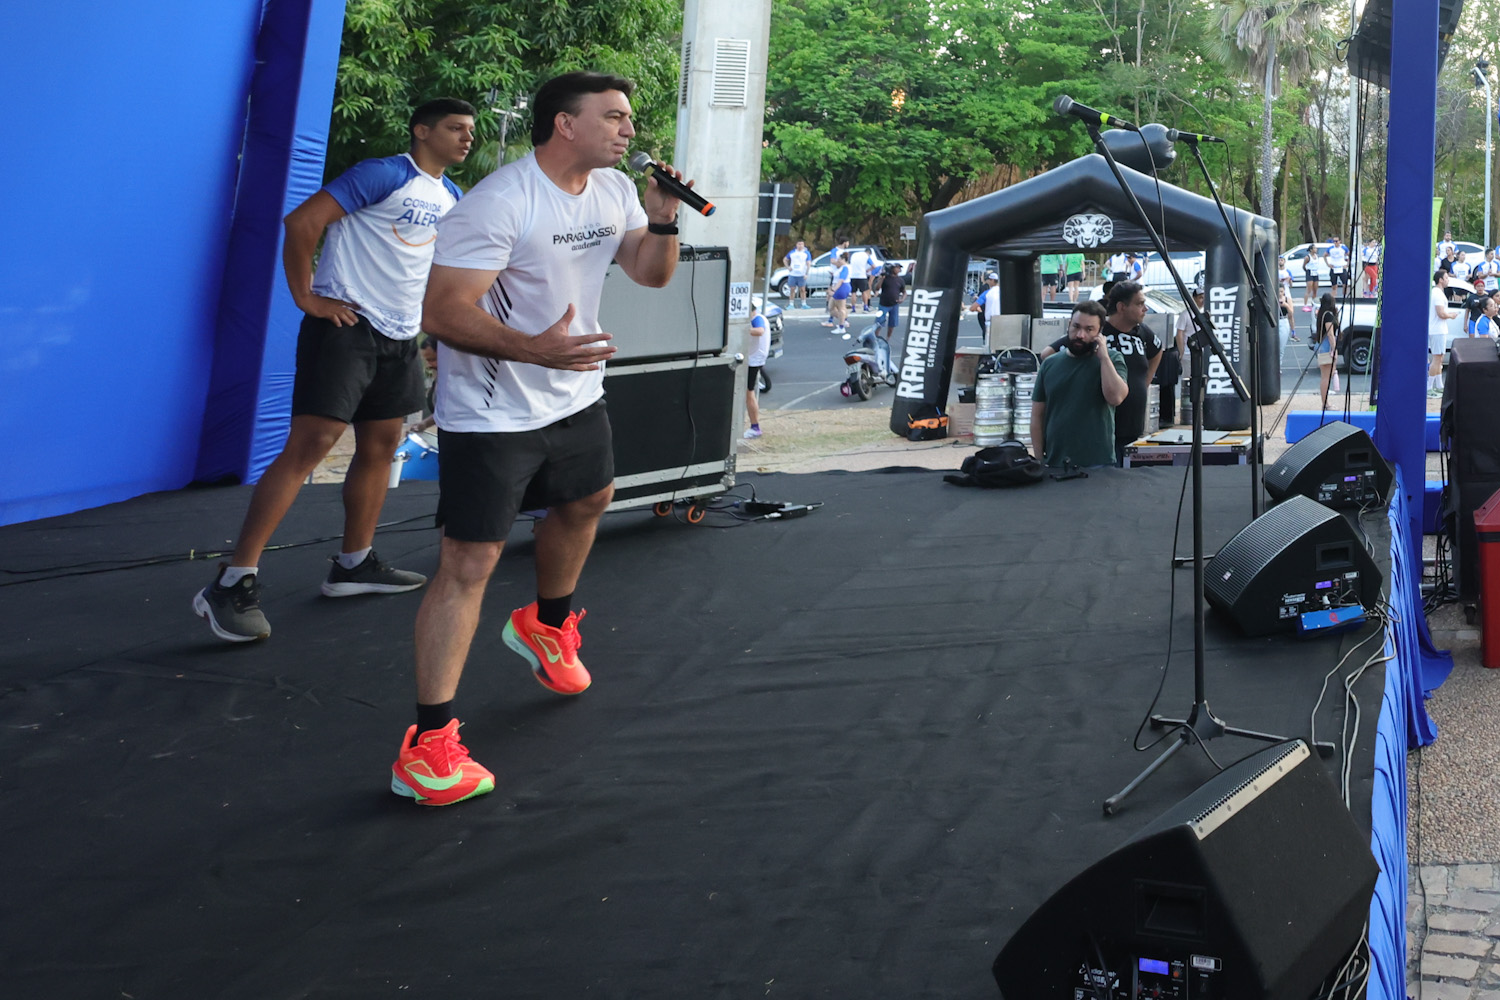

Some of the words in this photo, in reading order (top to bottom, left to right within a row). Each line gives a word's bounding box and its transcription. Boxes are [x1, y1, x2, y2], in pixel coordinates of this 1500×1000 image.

[402, 197, 442, 213] CORRIDA
[553, 224, 617, 245] PARAGUASSÚ
[571, 239, 601, 251] academia
[896, 288, 943, 399] RAMBEER
[927, 321, 942, 368] CERVEJARIA
[1233, 316, 1241, 362] CERVEJARIA
